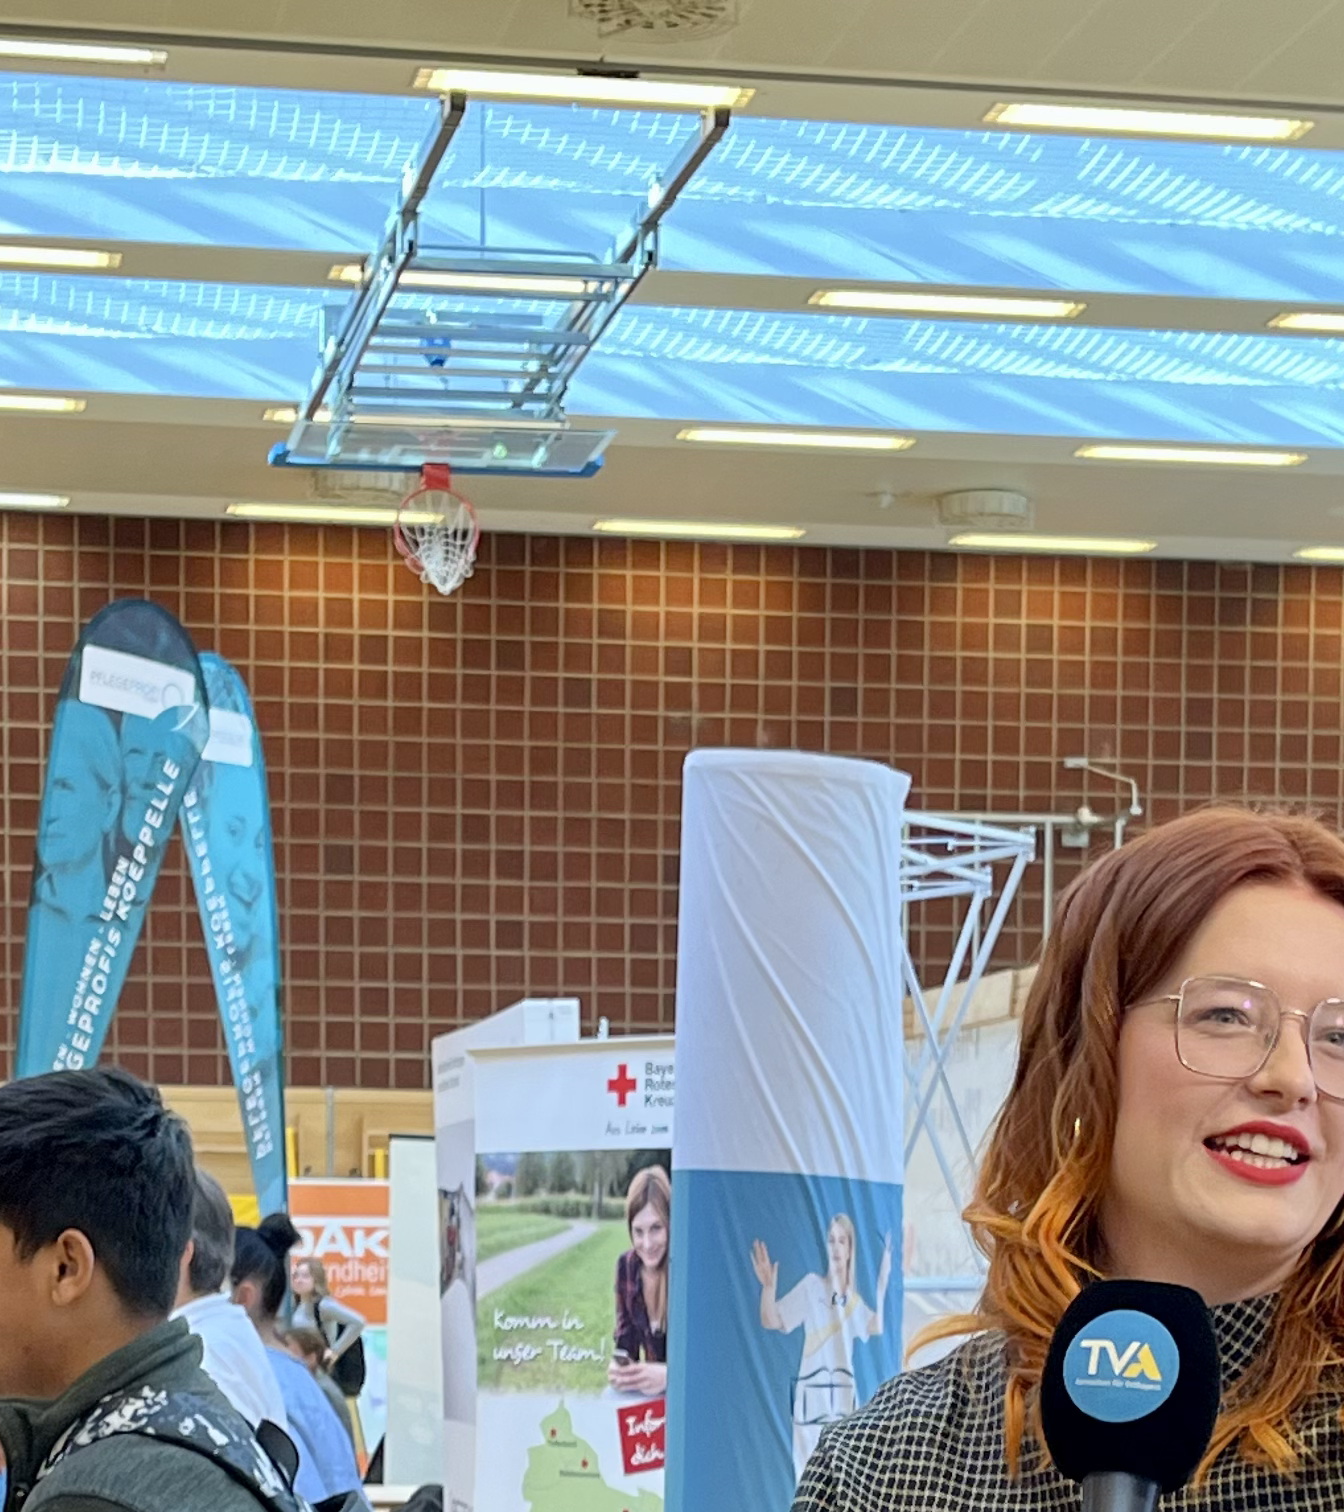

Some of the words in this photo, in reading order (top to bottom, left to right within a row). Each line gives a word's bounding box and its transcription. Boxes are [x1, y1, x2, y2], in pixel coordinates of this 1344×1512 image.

[117, 758, 181, 921] KOEPPELLE
[100, 855, 129, 922] LEBEN
[493, 1308, 557, 1331] Komm
[563, 1309, 584, 1331] in
[493, 1345, 543, 1366] unser
[546, 1337, 605, 1363] Team!
[1080, 1339, 1162, 1382] TVA
